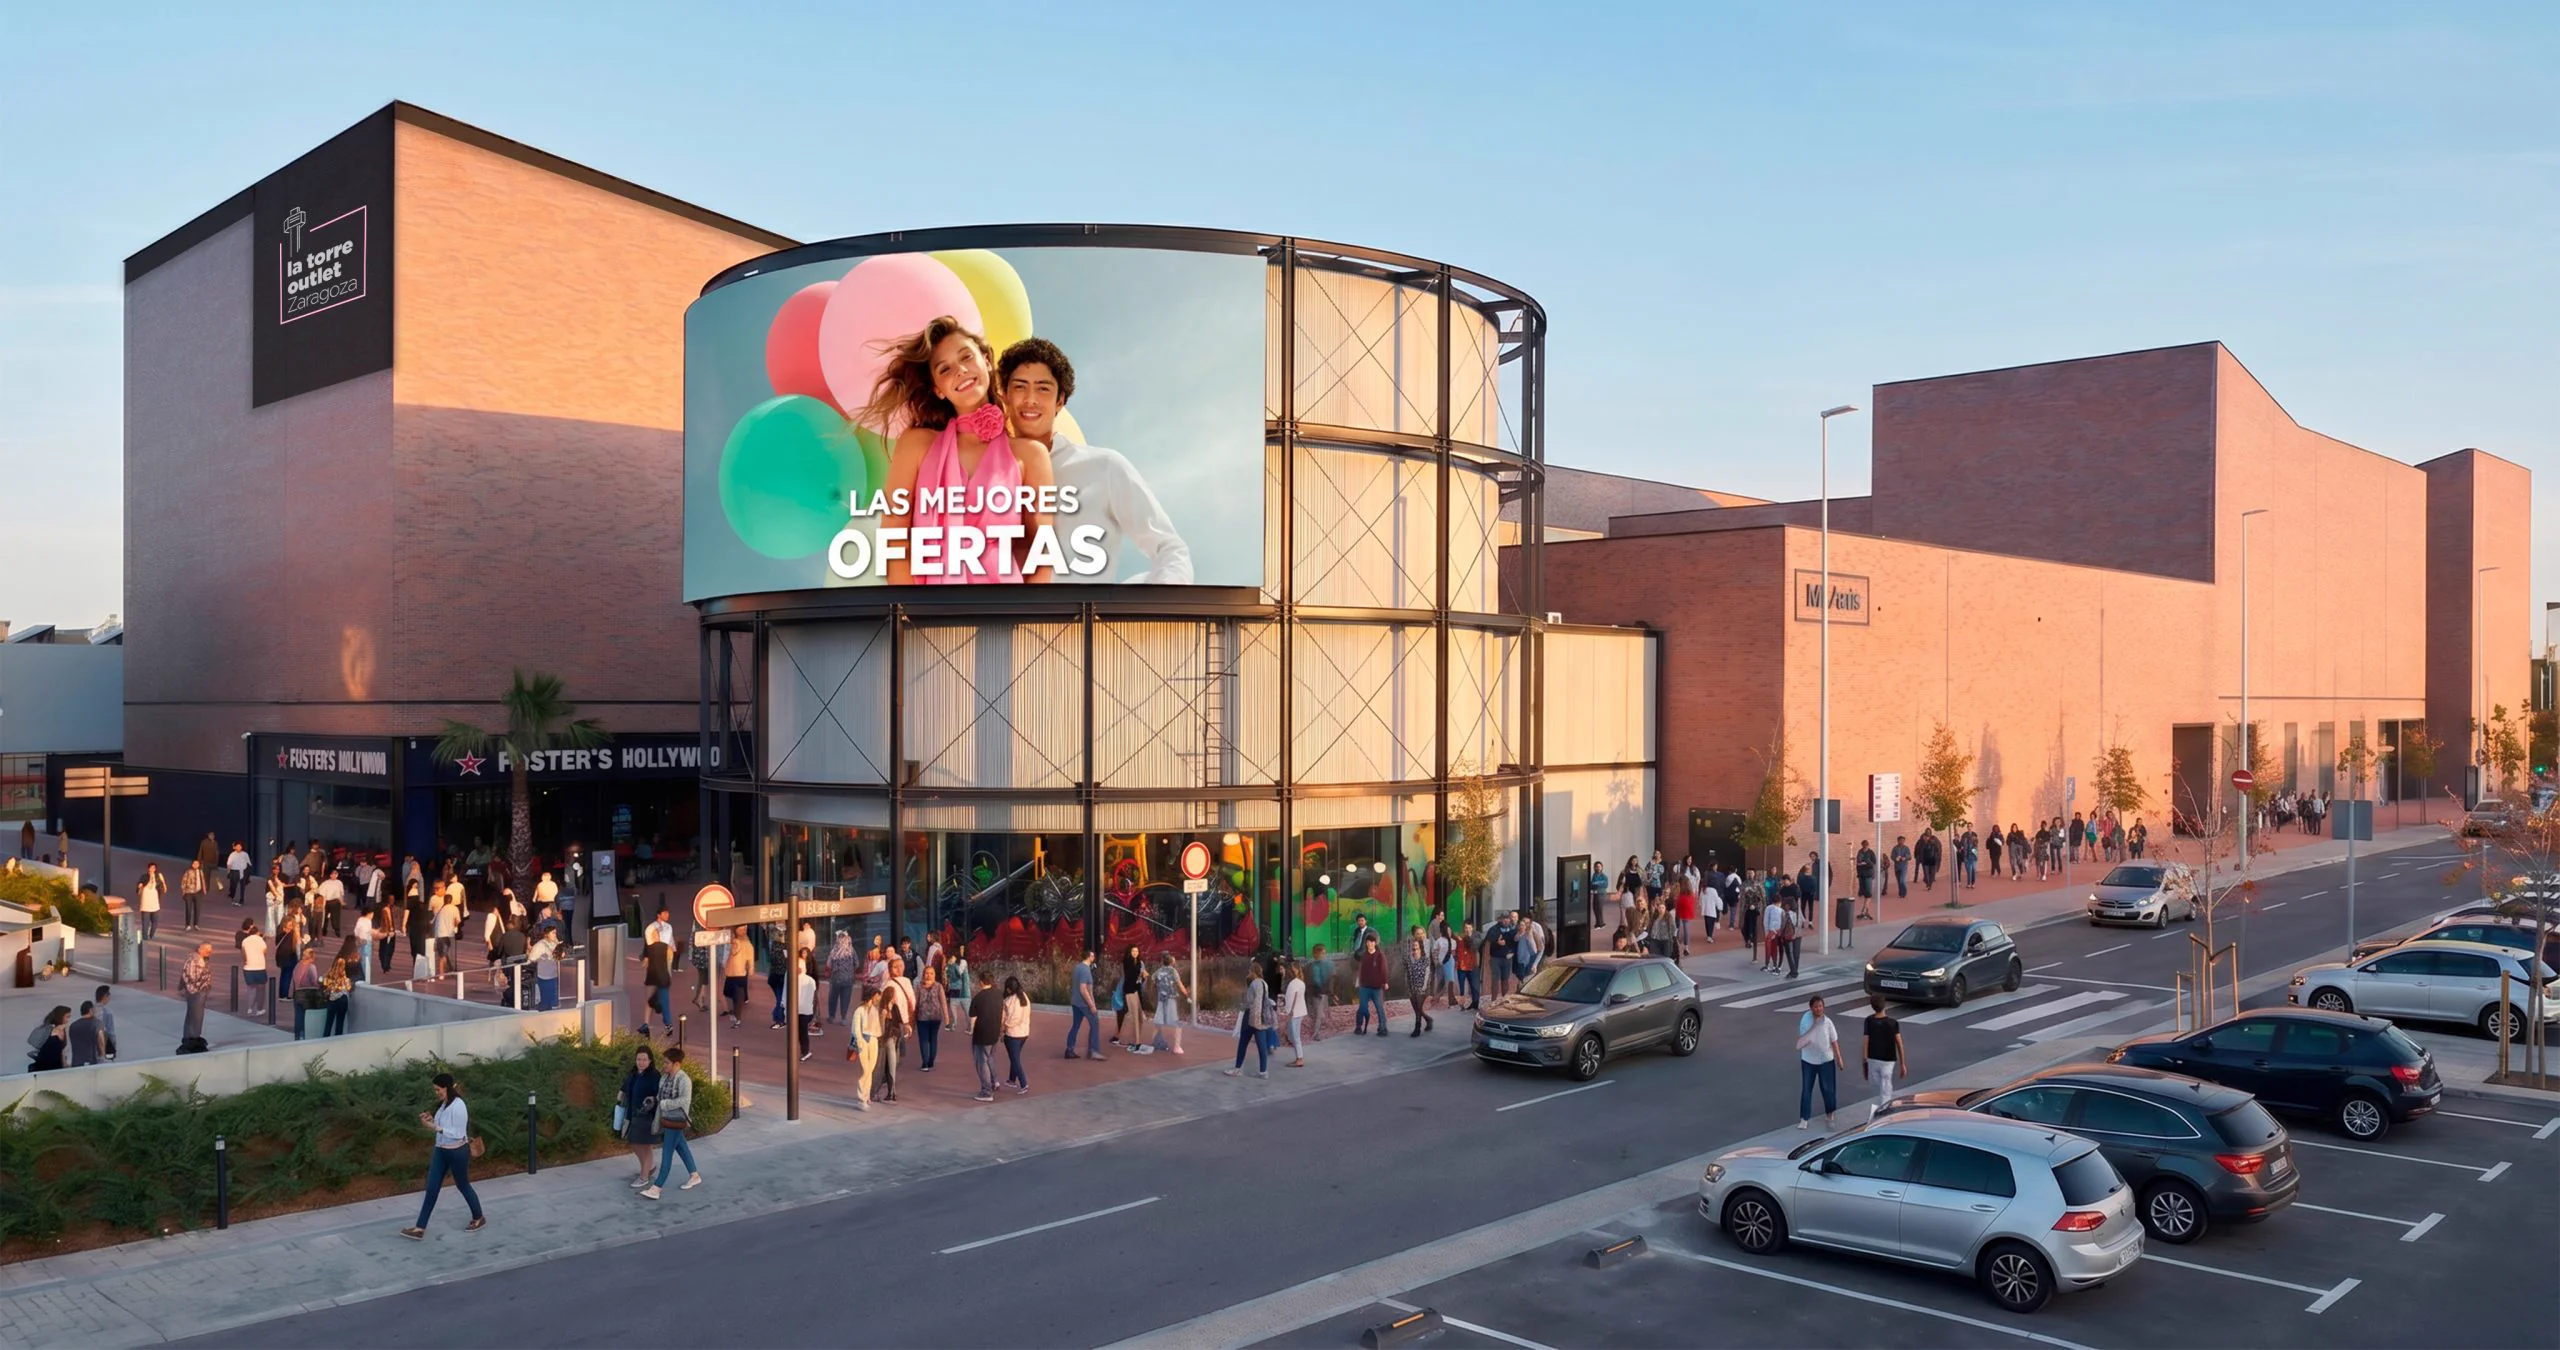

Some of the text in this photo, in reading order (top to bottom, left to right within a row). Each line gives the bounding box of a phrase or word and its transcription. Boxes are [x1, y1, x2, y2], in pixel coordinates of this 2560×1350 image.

[287, 240, 354, 278] la torre
[287, 261, 342, 295] outlet
[287, 278, 358, 314] Zaragoza
[850, 485, 1080, 517] LAS MEJORES
[828, 524, 1109, 579] OFERTAS
